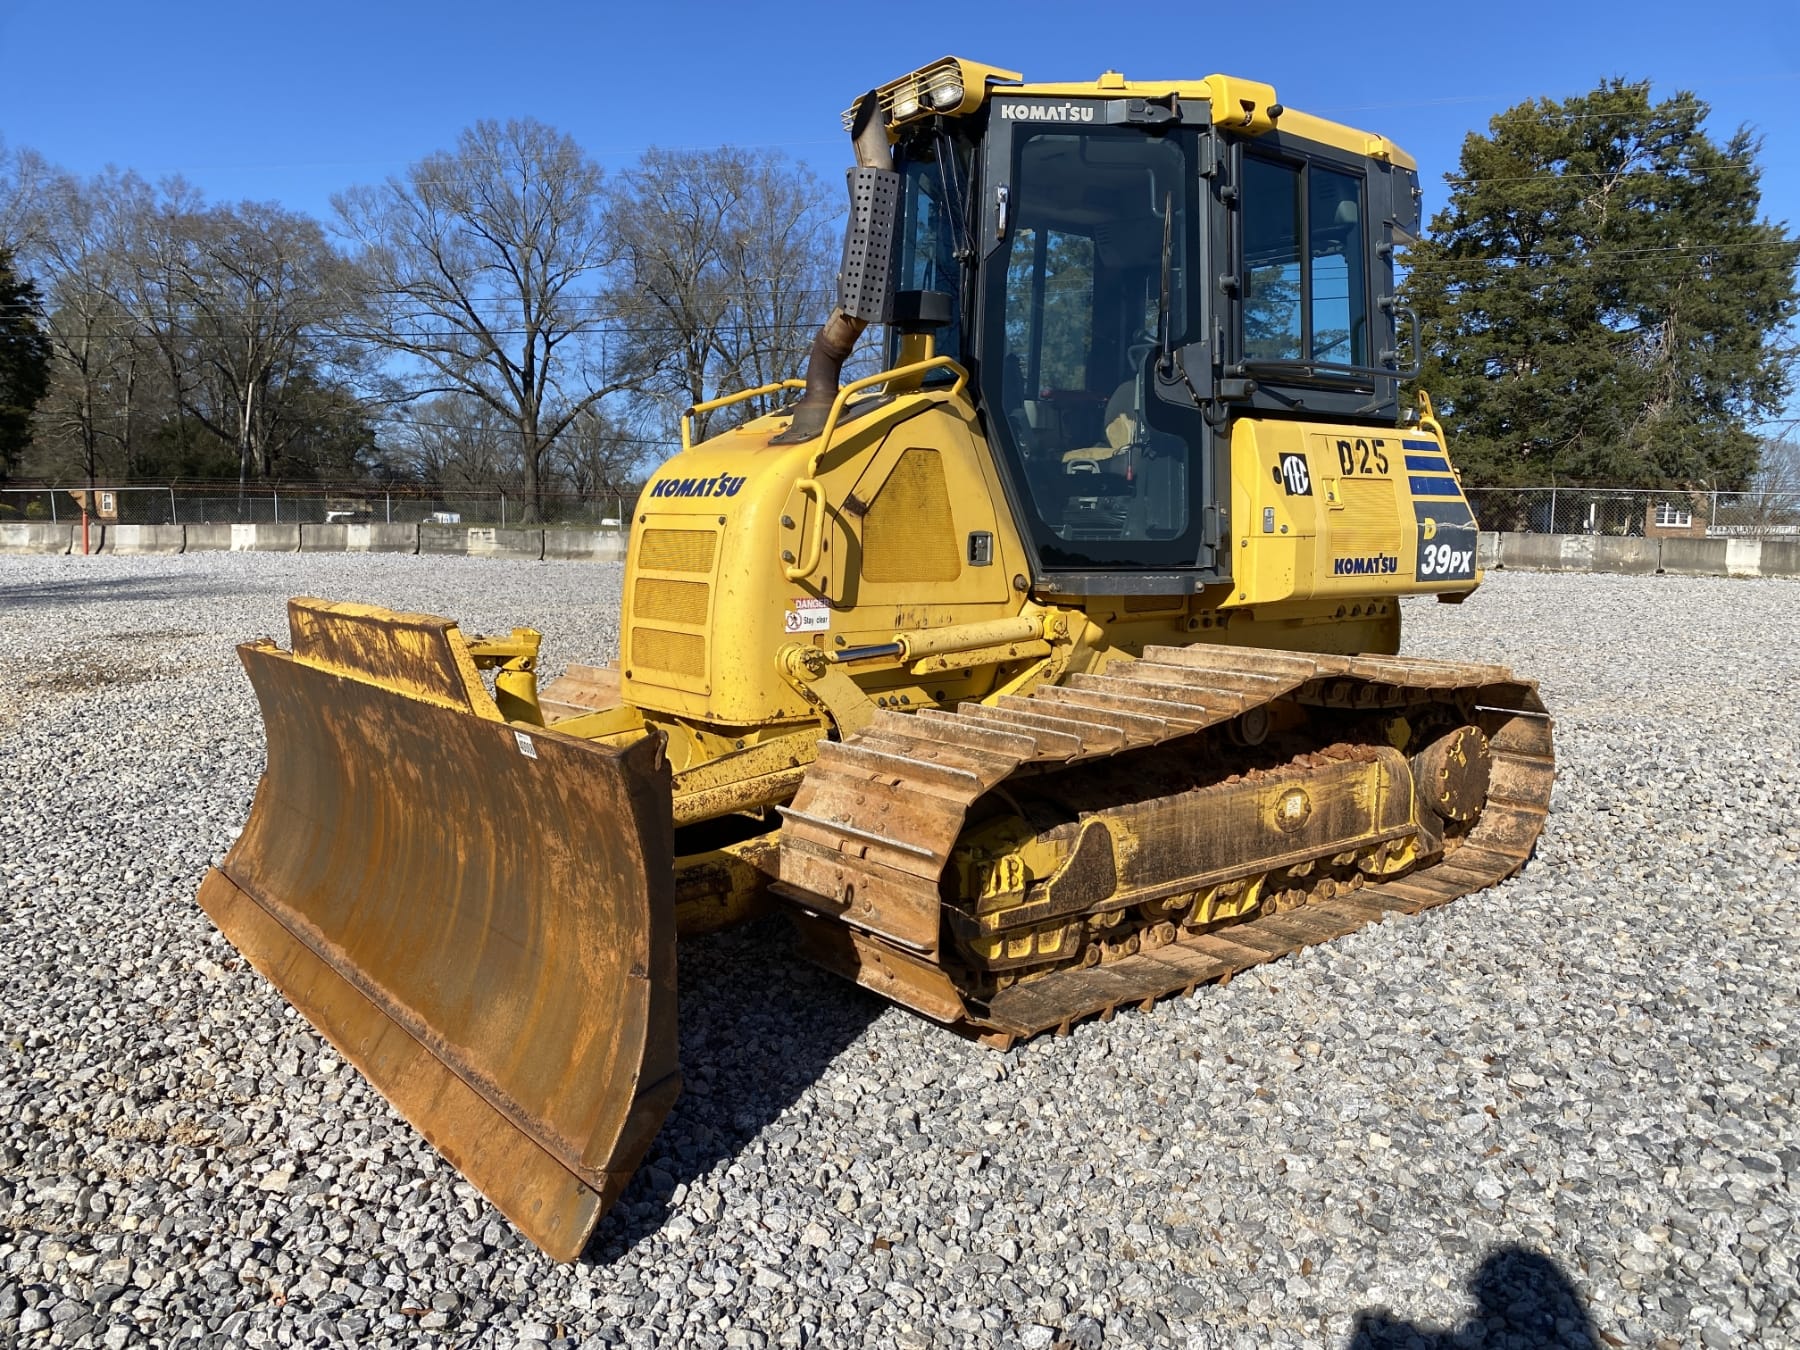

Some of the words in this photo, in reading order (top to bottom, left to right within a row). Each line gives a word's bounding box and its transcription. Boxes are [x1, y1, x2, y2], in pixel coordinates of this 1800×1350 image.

[1001, 102, 1093, 121] KOMATSU
[1336, 439, 1389, 475] D25
[650, 472, 747, 497] KOMATSU
[1424, 517, 1437, 540] D
[1334, 552, 1398, 575] KOMATSU
[1421, 544, 1473, 575] 39PX
[795, 598, 830, 609] DANGER
[803, 616, 814, 626] Stay
[816, 615, 828, 624] clear
